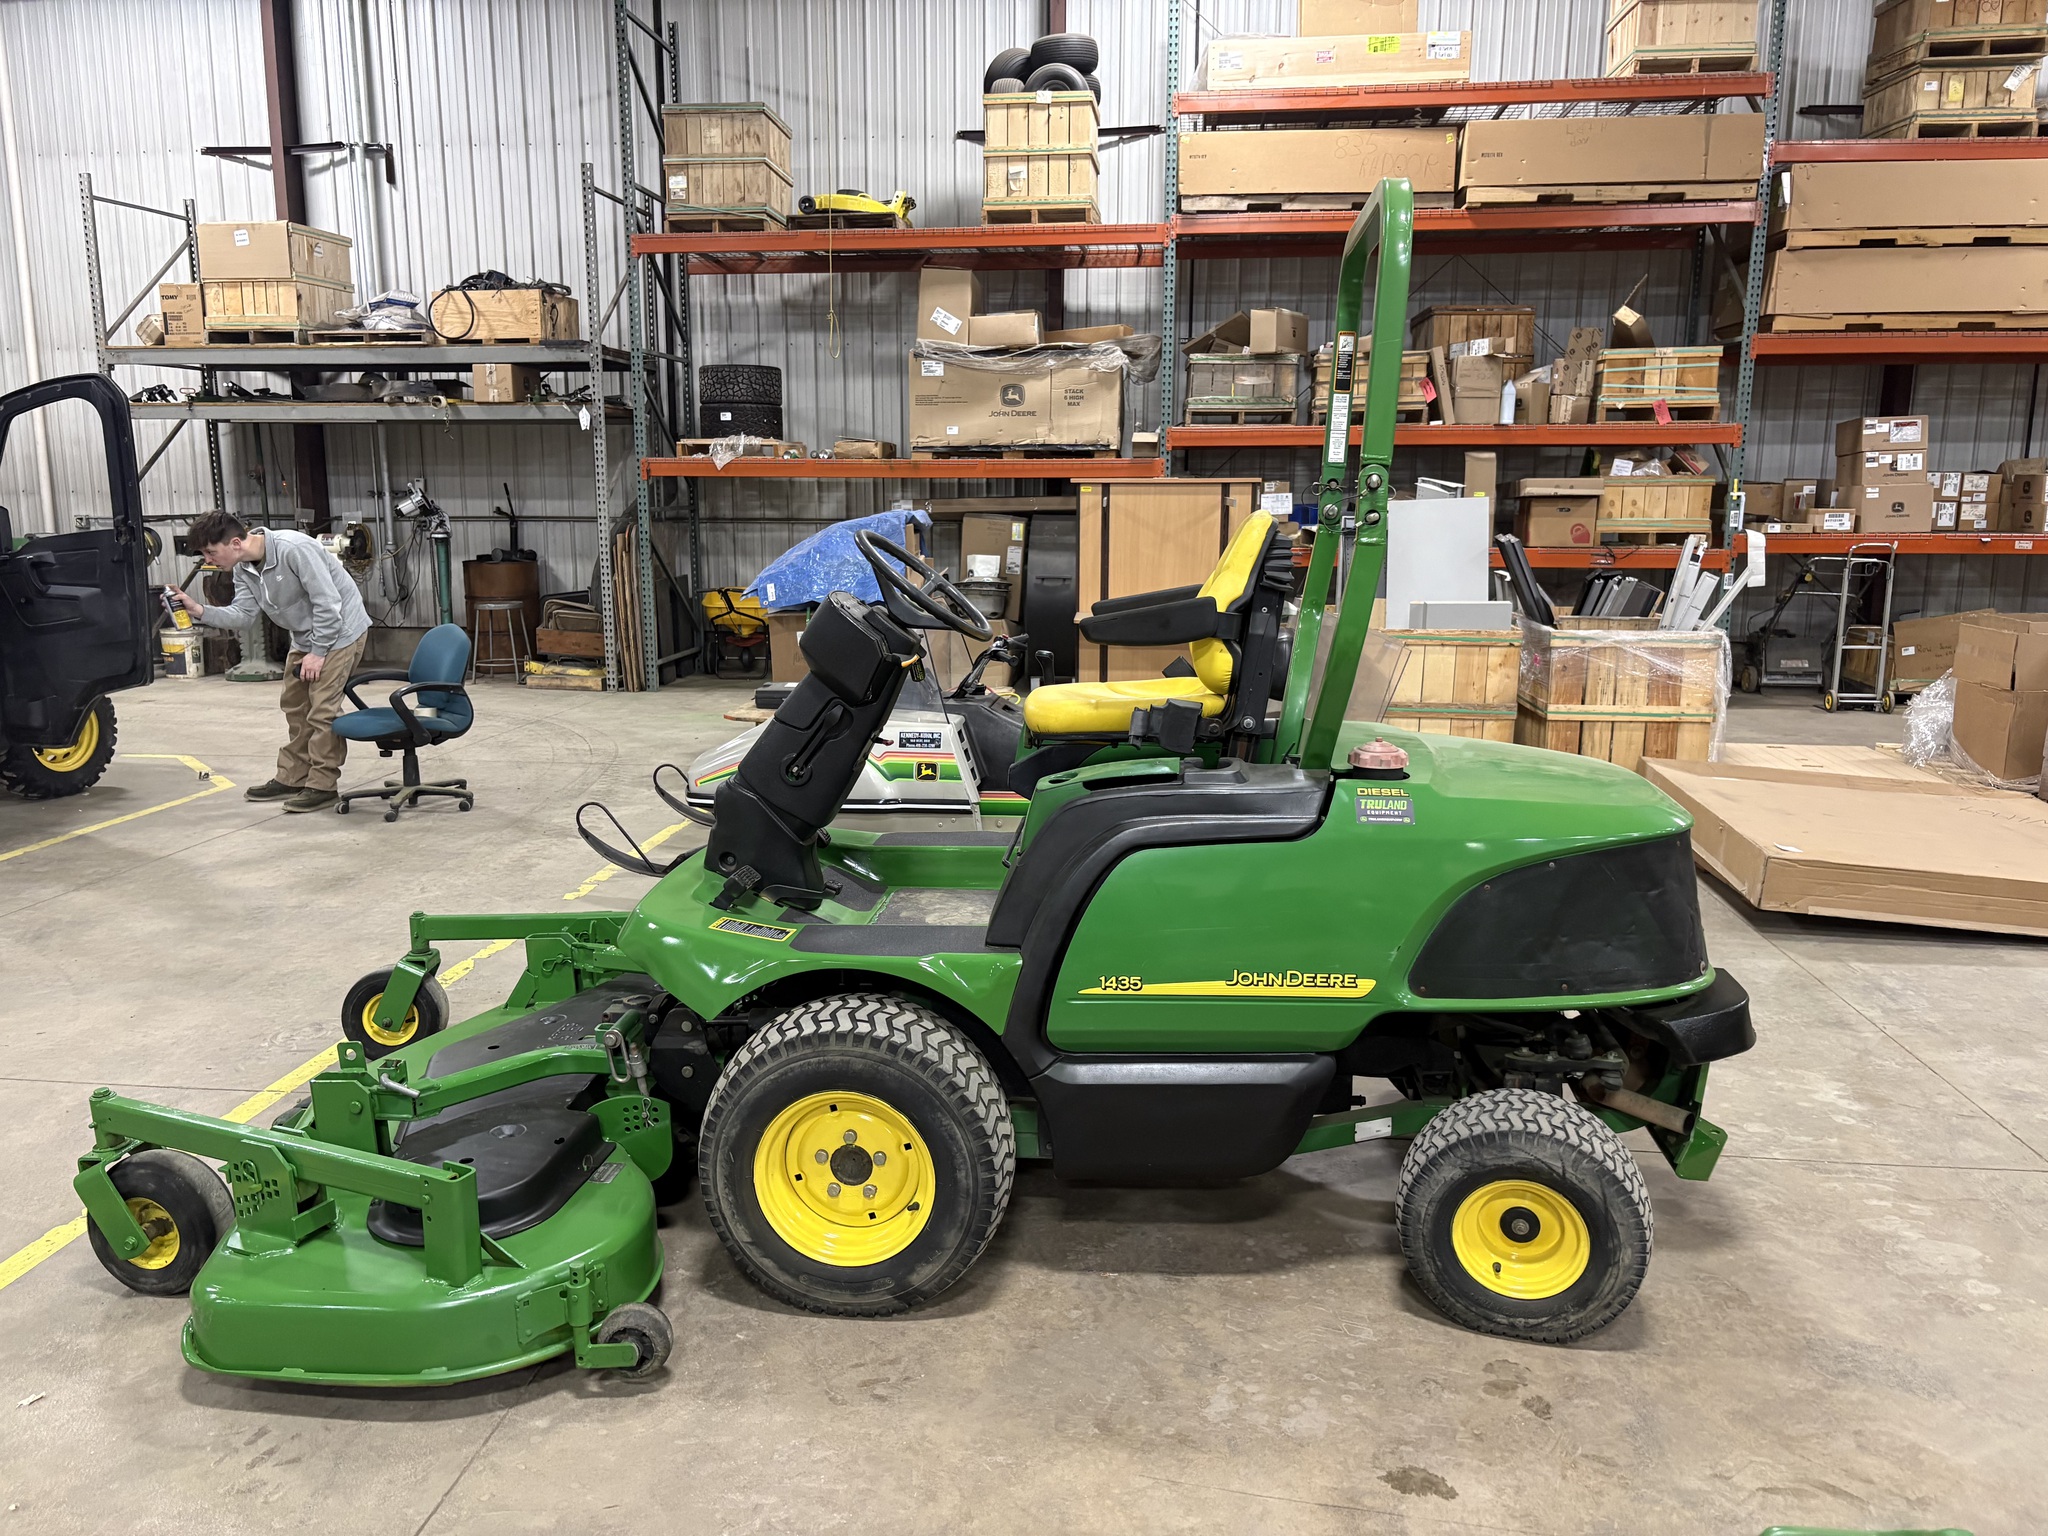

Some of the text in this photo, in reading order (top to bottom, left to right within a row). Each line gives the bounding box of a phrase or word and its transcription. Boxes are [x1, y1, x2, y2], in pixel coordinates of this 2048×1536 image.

[988, 410, 1010, 418] JOHN
[1356, 787, 1409, 797] DIESEL
[1359, 799, 1408, 810] TRULAND
[1098, 975, 1143, 991] 1435
[1225, 969, 1358, 989] JOHN DEERE
